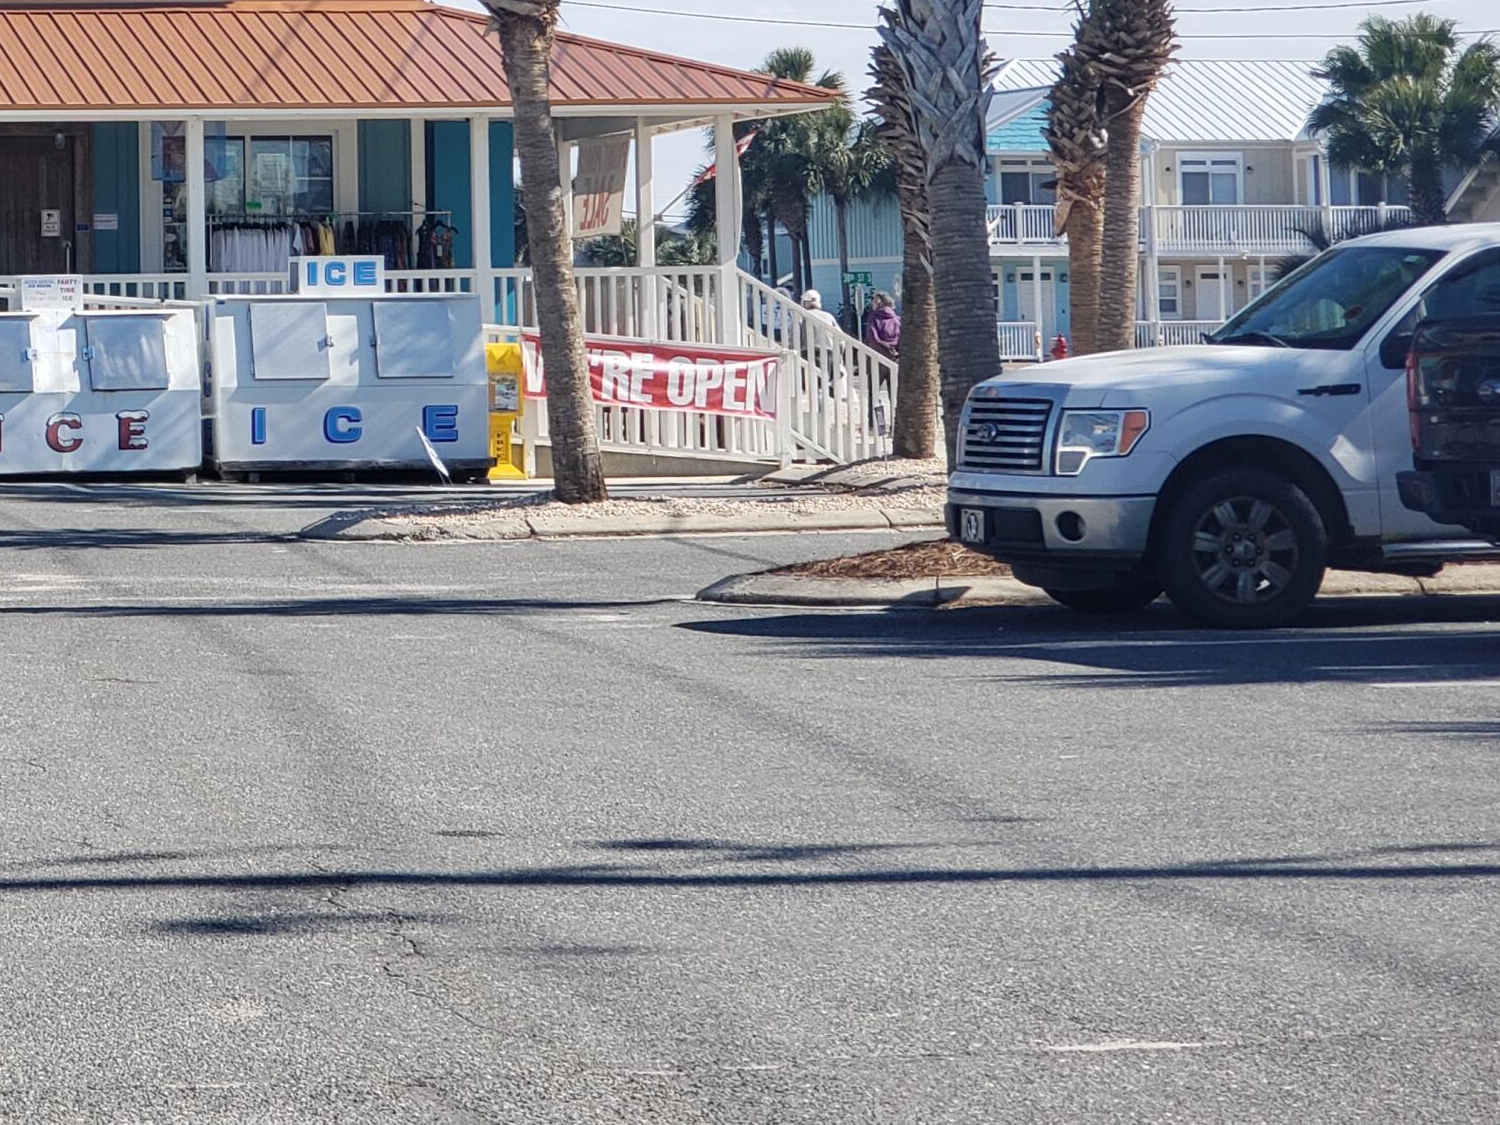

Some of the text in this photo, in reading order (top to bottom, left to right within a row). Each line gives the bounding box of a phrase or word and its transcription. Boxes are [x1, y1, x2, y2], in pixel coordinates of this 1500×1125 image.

[307, 261, 377, 286] ICE
[667, 355, 776, 413] OPEN
[251, 404, 458, 444] ICE
